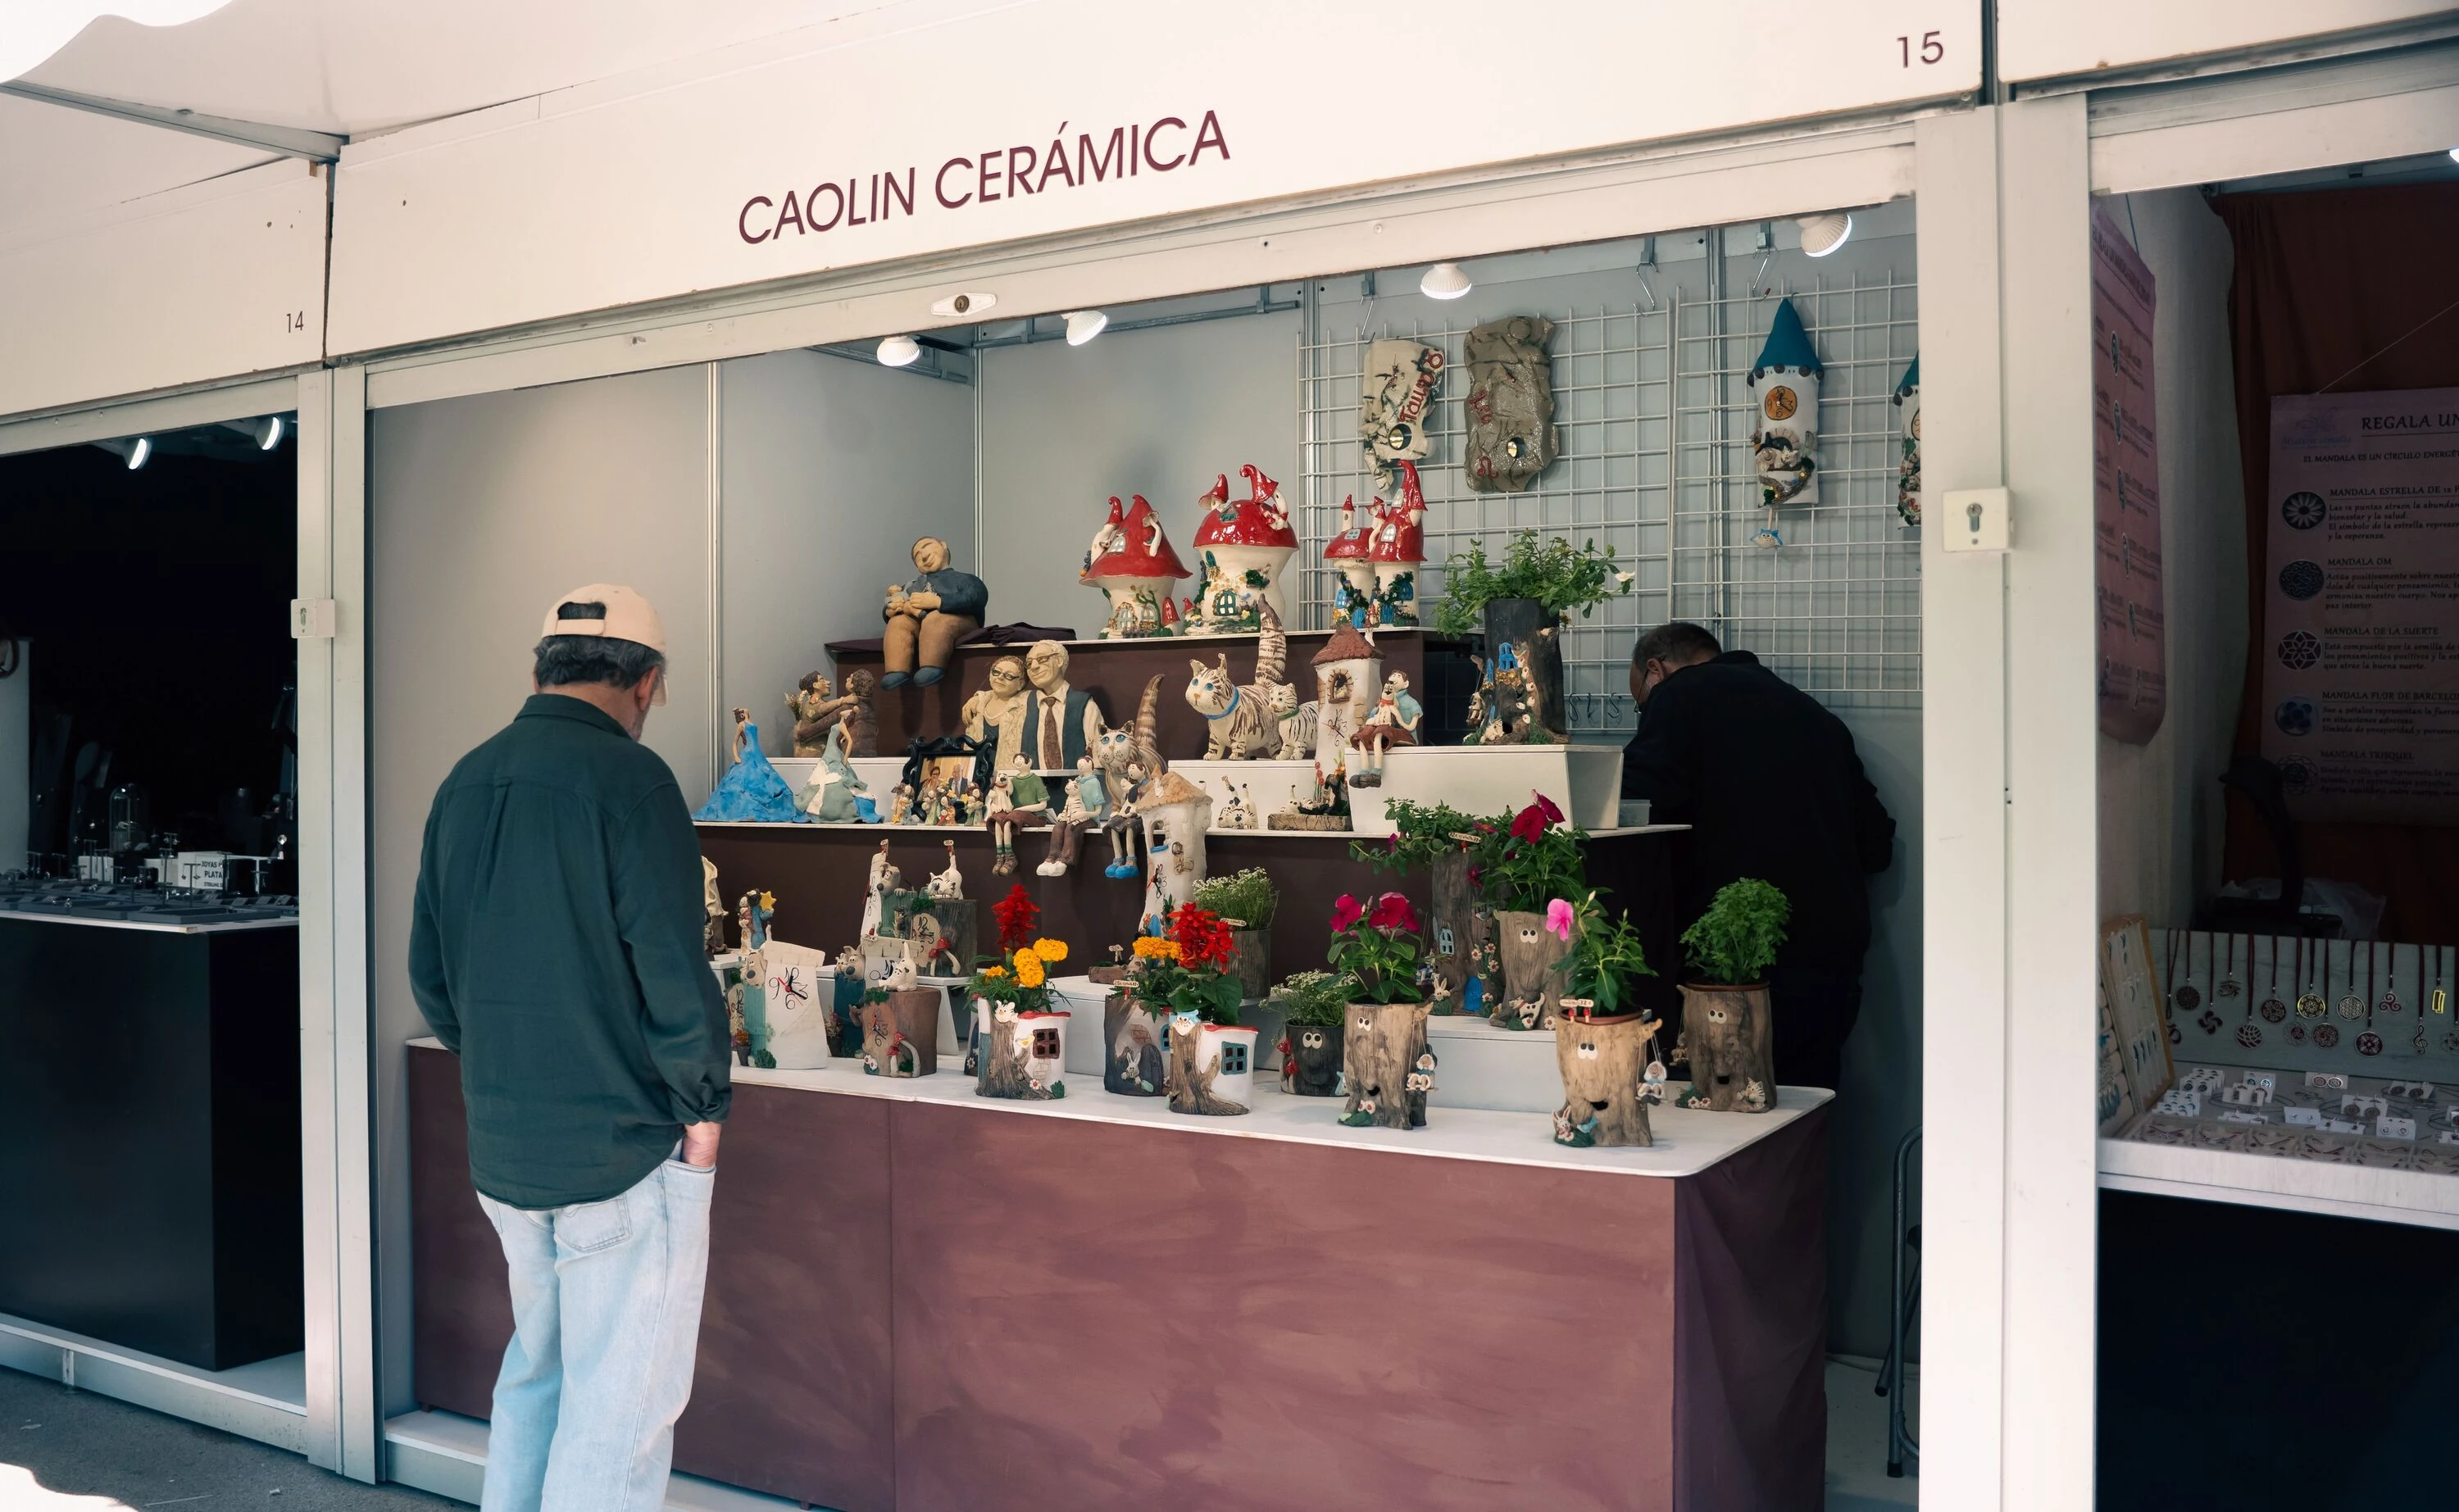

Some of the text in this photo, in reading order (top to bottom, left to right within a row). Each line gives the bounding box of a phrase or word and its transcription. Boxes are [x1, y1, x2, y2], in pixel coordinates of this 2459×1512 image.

[1896, 30, 1943, 68] 15
[739, 110, 1231, 244] CAOLIN CERÁMICA
[287, 311, 303, 334] 14
[1398, 371, 1434, 423] Tauro
[1469, 389, 1492, 425] Leo
[2361, 415, 2431, 430] REGALA
[2315, 454, 2356, 463] MANDALA
[2358, 453, 2367, 461] ES
[2384, 452, 2421, 461] CÍRCULO
[2329, 488, 2375, 496] MANDALA
[2379, 487, 2424, 495] ESTRELLA
[2427, 485, 2440, 493] DE
[2355, 503, 2382, 512] puntas
[2413, 501, 2420, 509] la
[2372, 521, 2381, 529] de
[2393, 520, 2423, 529] estrella
[2328, 534, 2333, 543] y
[2352, 573, 2407, 582] positivamente
[2410, 570, 2431, 579] sobre
[2326, 581, 2343, 589] dola
[2345, 581, 2355, 589] de
[2357, 581, 2394, 591] cualquier
[2324, 627, 2439, 635] MANDALA DE LA SUERTE
[2343, 642, 2385, 652] compuesto
[2404, 642, 2411, 650] la
[2414, 642, 2443, 650] semilla
[2445, 642, 2455, 650] de
[2324, 652, 2335, 660] los
[2337, 652, 2391, 661] pensamientos
[2439, 652, 2446, 660] la
[2370, 692, 2394, 700] FLOR
[2375, 707, 2422, 715] representan
[2320, 751, 2414, 761] MANDALA TRISQUEL
[204, 870, 223, 879] PLATA
[769, 977, 780, 1000] 9
[785, 993, 796, 1010] 6
